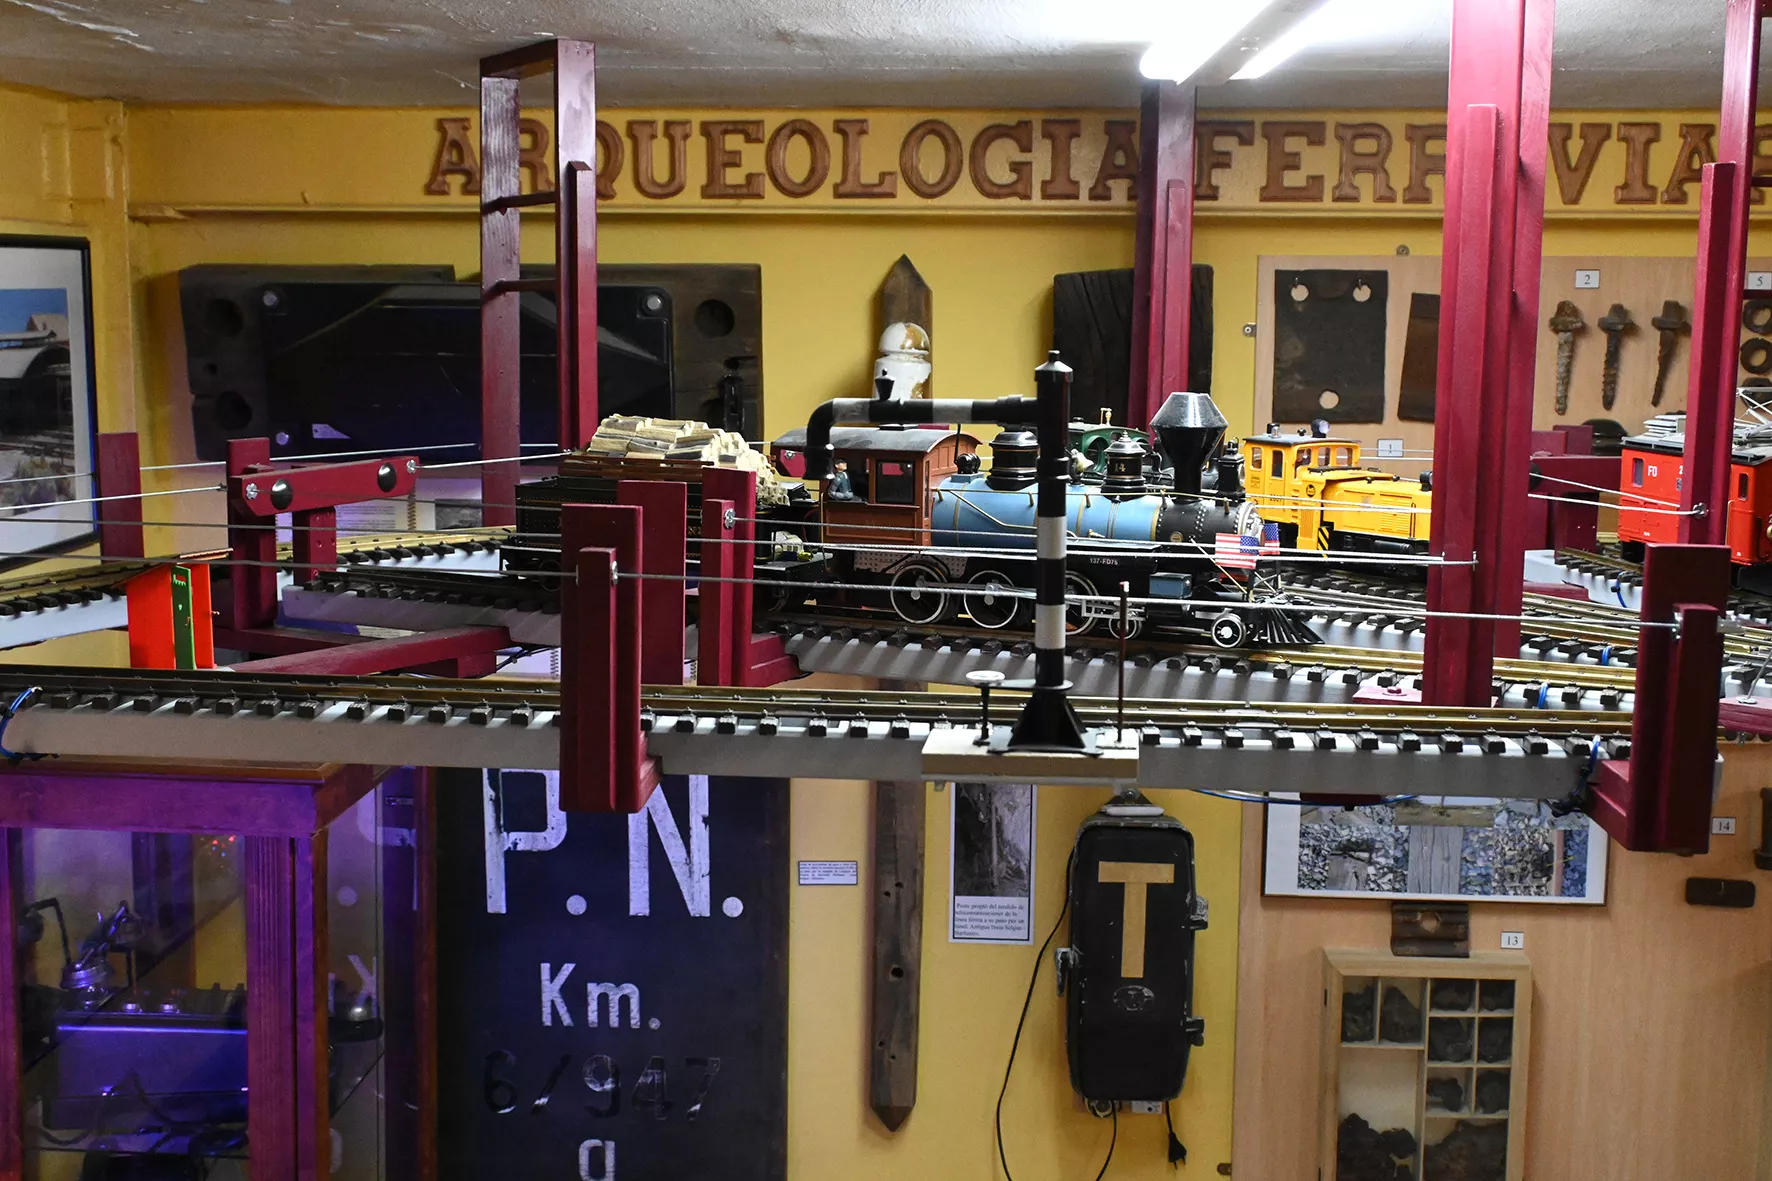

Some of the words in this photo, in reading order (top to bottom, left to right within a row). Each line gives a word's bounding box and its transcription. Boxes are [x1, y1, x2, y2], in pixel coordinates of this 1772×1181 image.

[1584, 274, 1591, 285] 2
[1755, 275, 1763, 287] 5
[1647, 465, 1658, 477] FO
[1718, 821, 1730, 831] 14
[1098, 861, 1175, 978] T
[1507, 935, 1519, 946] 13
[541, 963, 661, 1030] Km.
